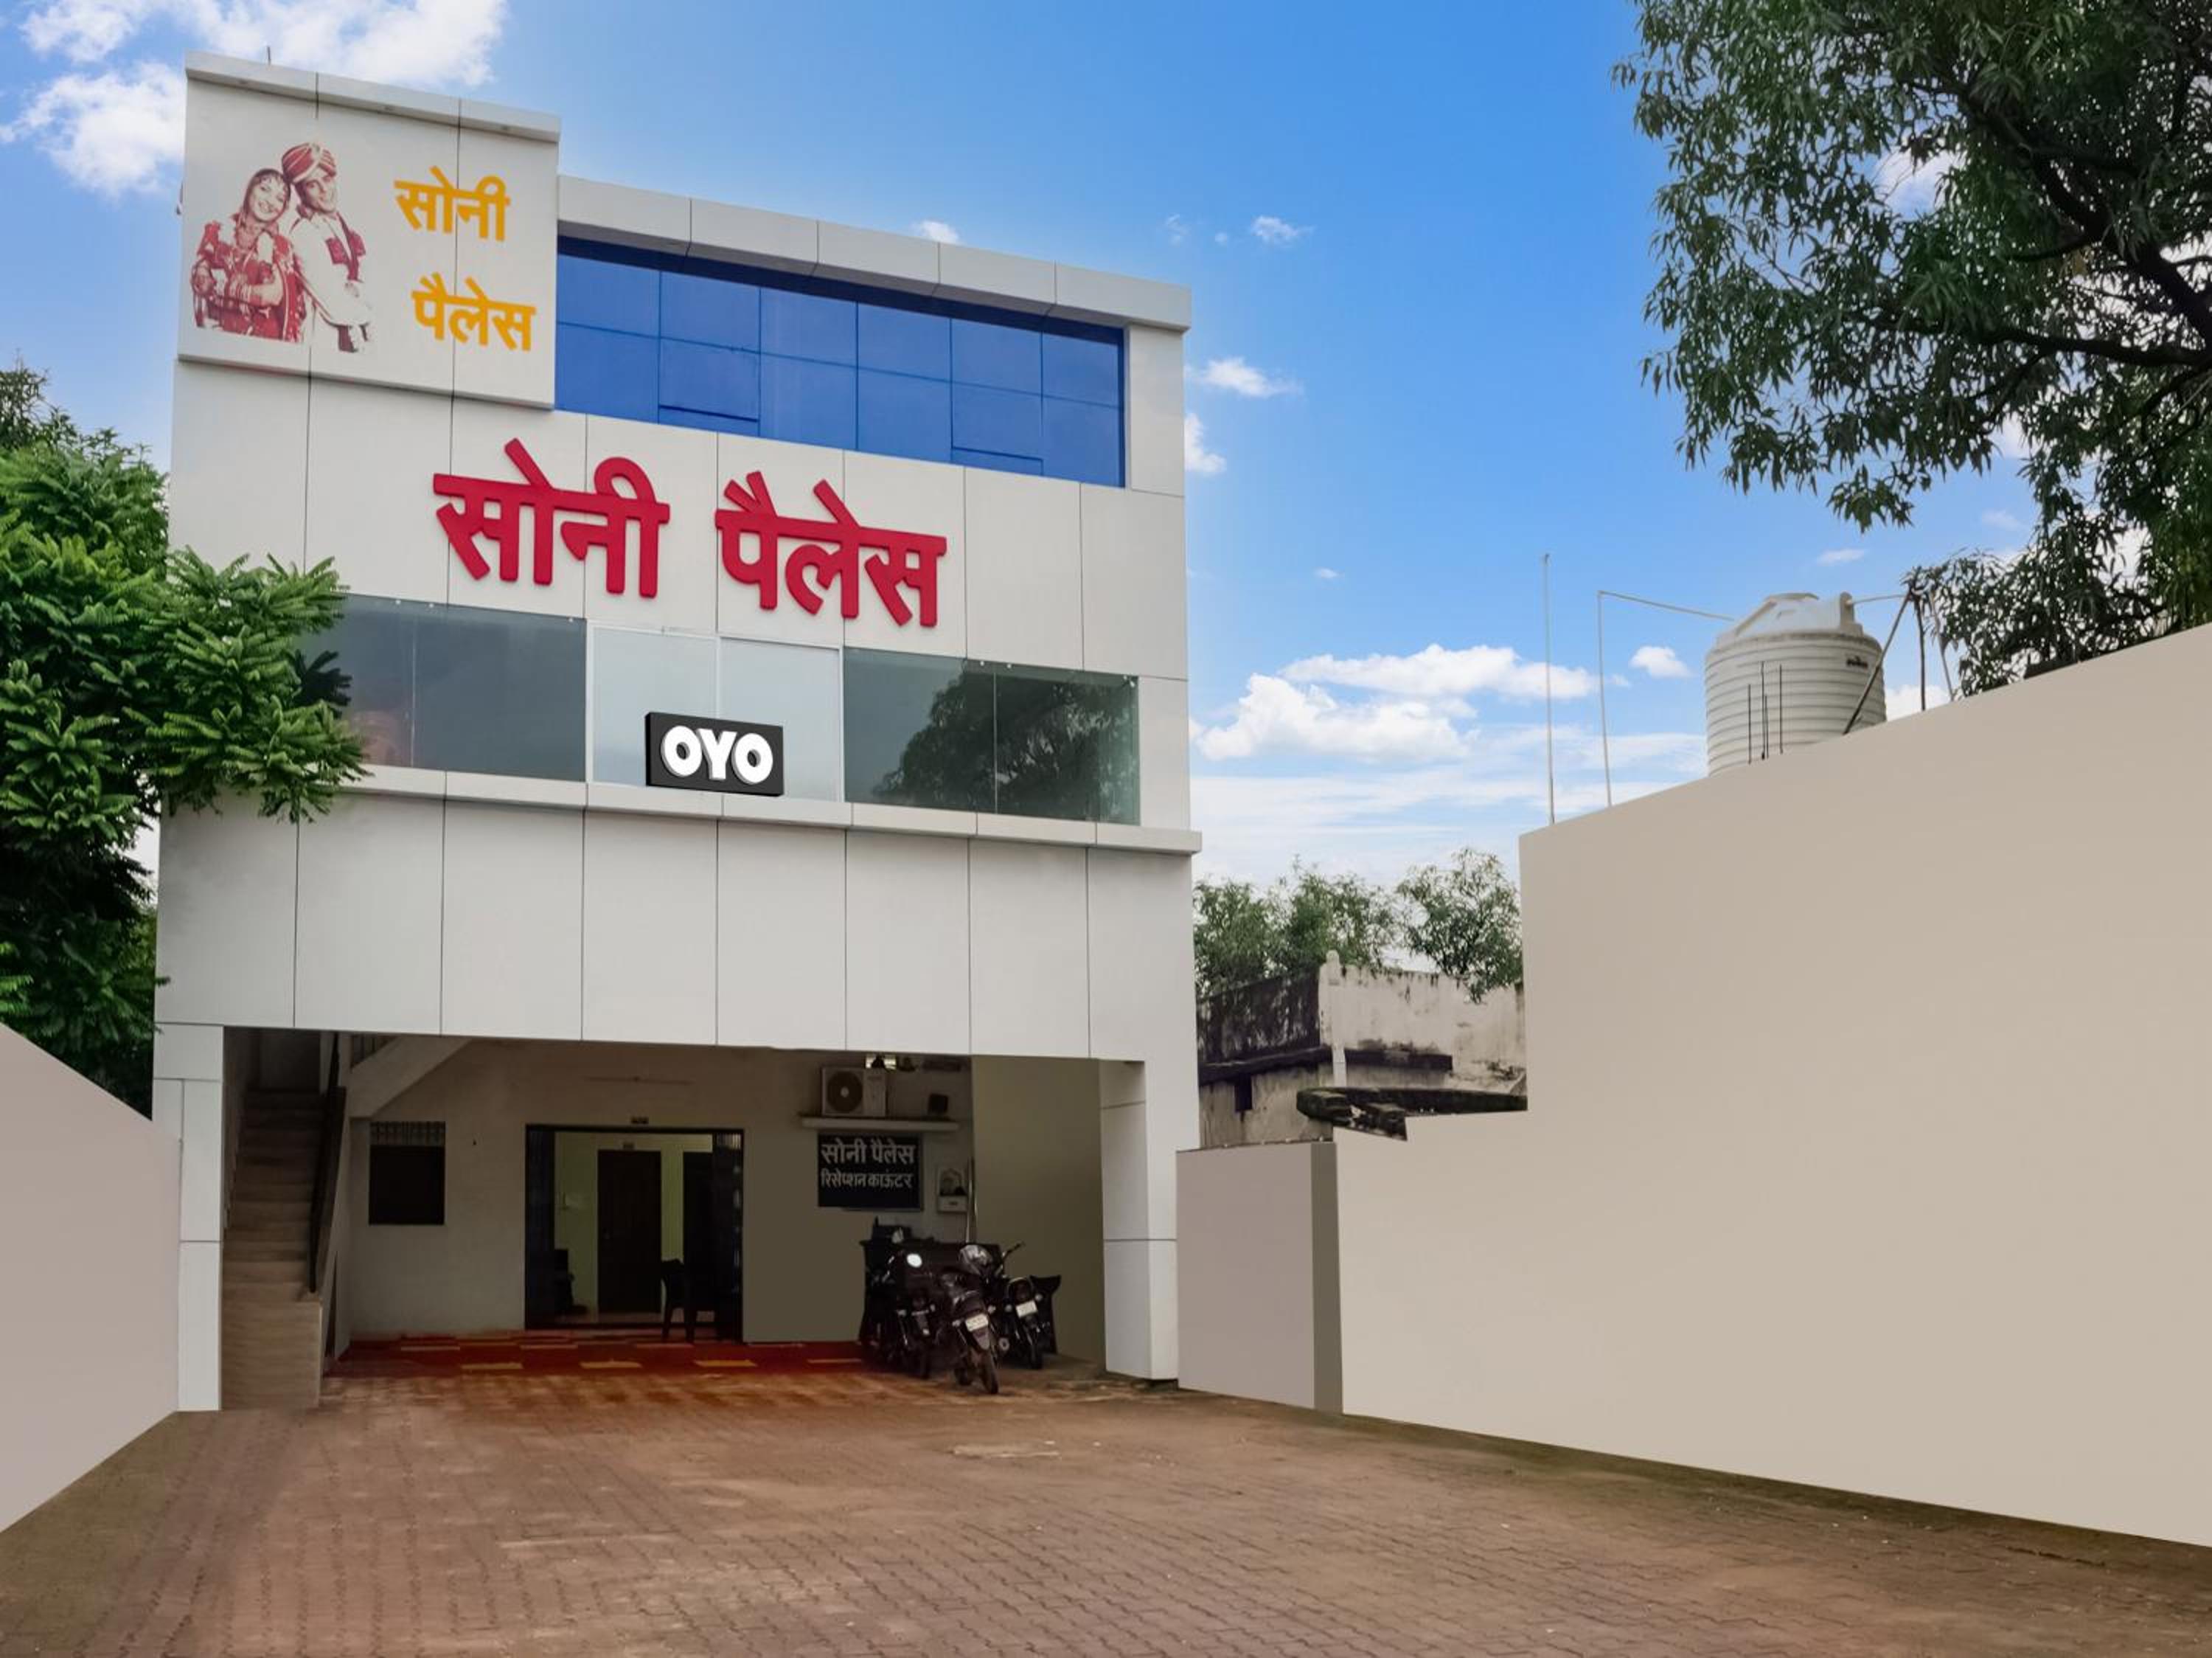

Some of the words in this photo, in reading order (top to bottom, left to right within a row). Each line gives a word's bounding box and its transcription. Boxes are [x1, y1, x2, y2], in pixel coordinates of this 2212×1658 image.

[394, 166, 510, 241] सोनी
[411, 272, 536, 351] पैलेस
[433, 438, 670, 599] सोनी
[714, 471, 947, 628] पैलेस
[661, 725, 773, 784] OYO
[821, 1137, 867, 1164] सोनी
[871, 1137, 916, 1165] पैलेस
